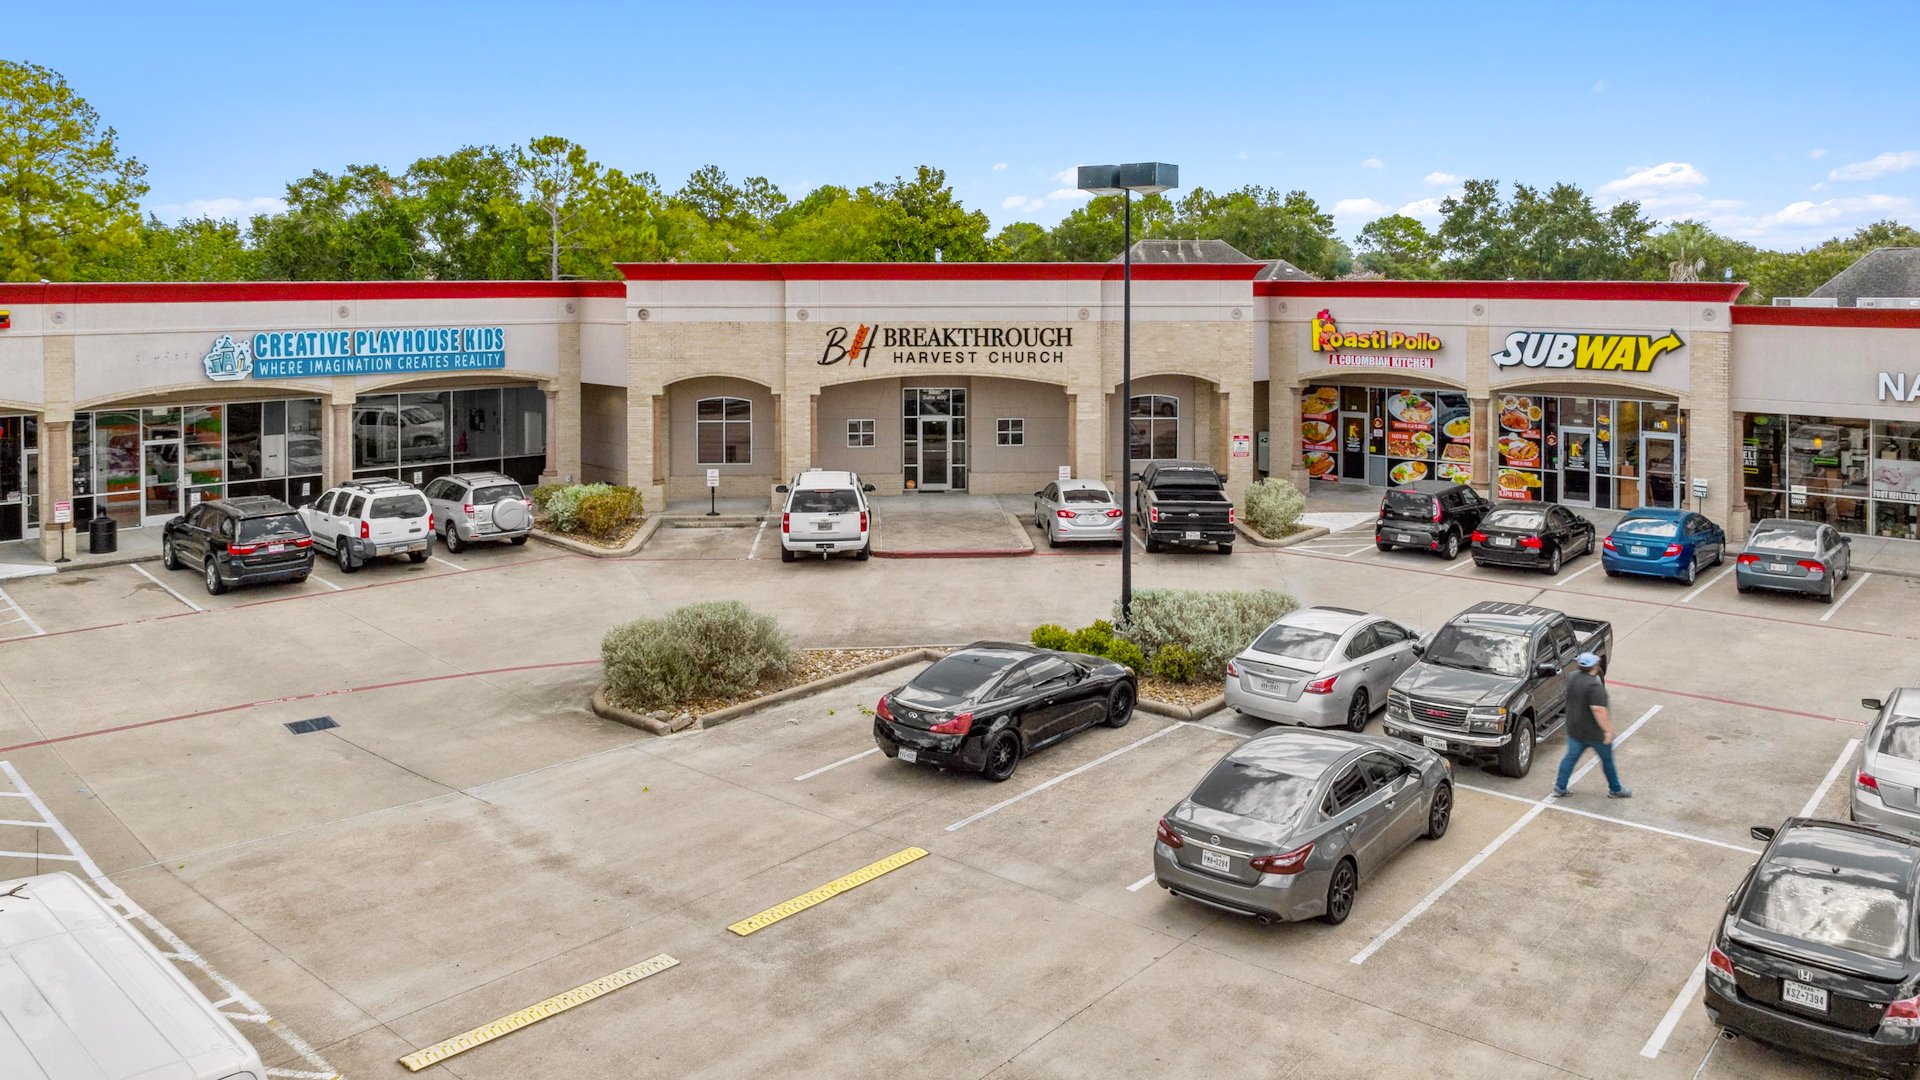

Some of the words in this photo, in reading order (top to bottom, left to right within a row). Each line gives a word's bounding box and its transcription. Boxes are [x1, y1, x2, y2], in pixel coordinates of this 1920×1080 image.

[255, 331, 350, 358] CREATIVE
[355, 328, 461, 356] PLAYHOUSE
[463, 327, 504, 351] KIDS
[883, 327, 1073, 347] BREAKTHROUGH
[1311, 317, 1387, 352] Roasti
[1391, 331, 1442, 351] Pollo
[893, 351, 977, 363] HARVEST
[988, 351, 1064, 363] CHURCH
[1491, 329, 1686, 372] SUBWAY
[259, 361, 304, 376] WHERE
[310, 357, 392, 374] IMAGINATION
[398, 356, 449, 370] CREATES
[455, 353, 501, 367] REALITY
[1331, 355, 1338, 365] A
[1340, 355, 1390, 367] COLOMBIAN
[1392, 356, 1431, 368] KITCHEN
[1744, 451, 1757, 460] ELI
[1873, 490, 1888, 498] FOOT
[1797, 984, 1814, 993] TEXAS
